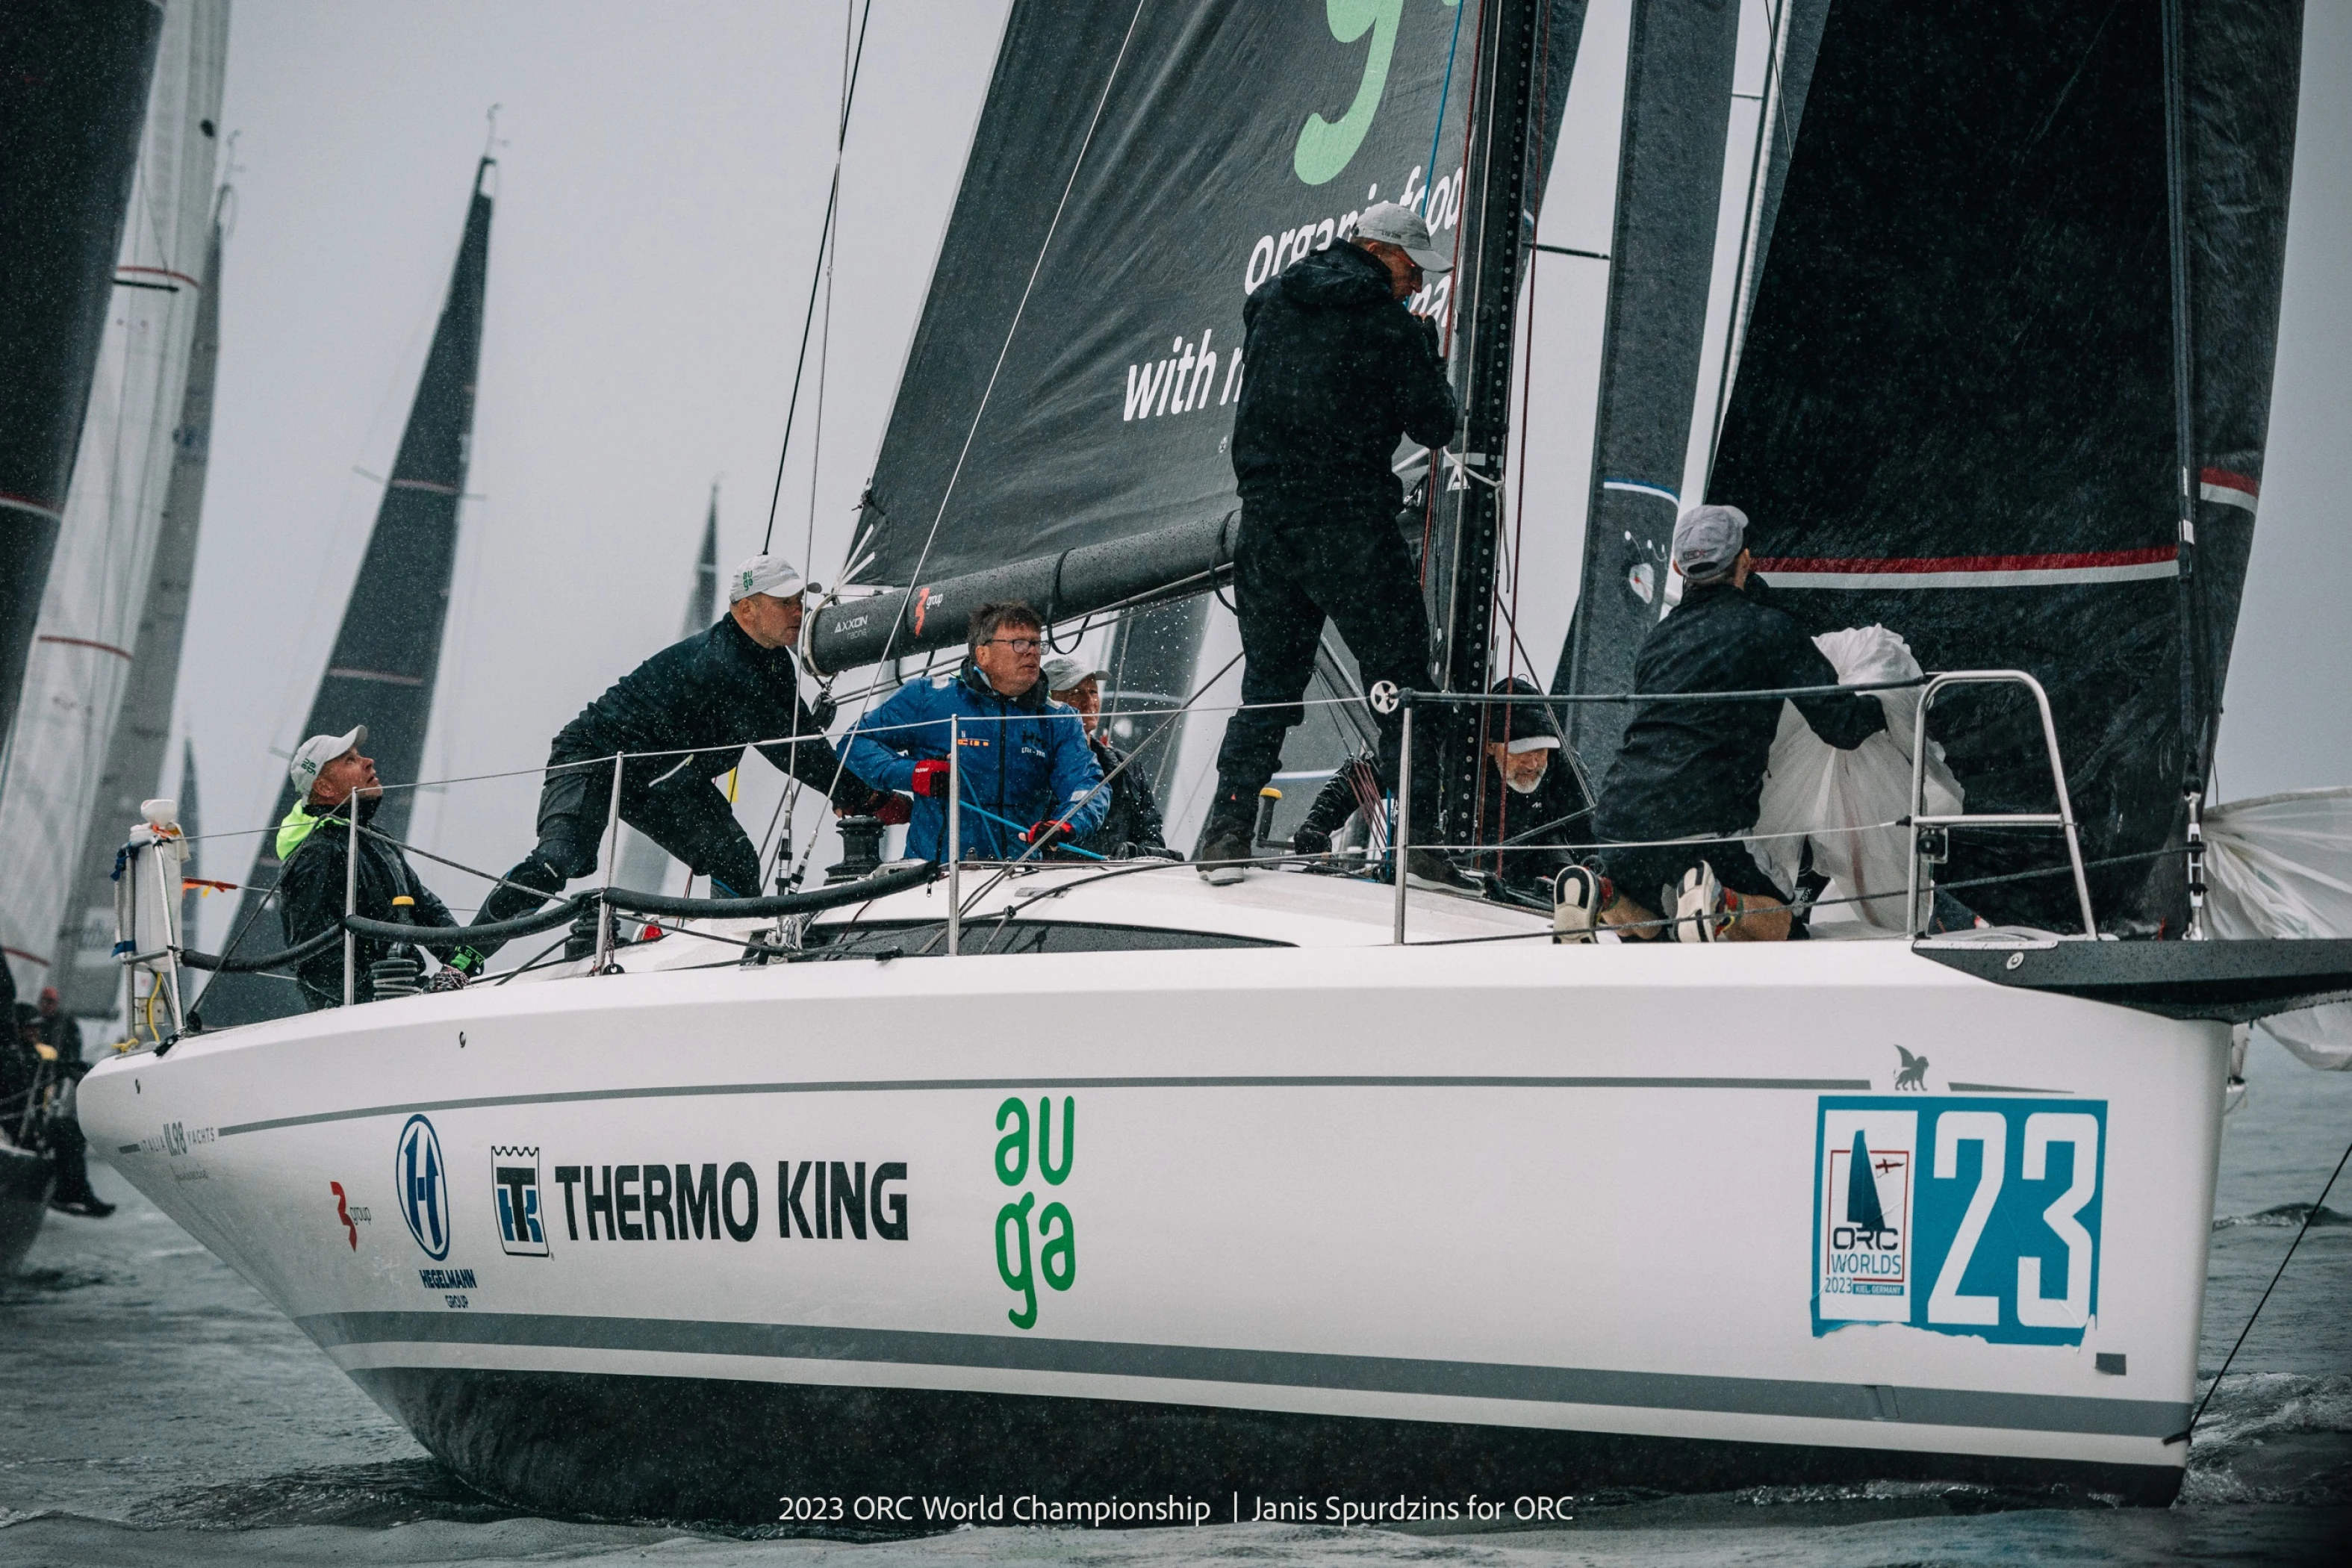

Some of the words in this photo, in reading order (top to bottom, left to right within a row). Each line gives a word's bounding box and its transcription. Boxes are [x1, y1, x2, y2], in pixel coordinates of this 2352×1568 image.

[1123, 328, 1217, 422] with
[926, 594, 944, 610] group
[834, 615, 868, 634] AXXON
[995, 1095, 1075, 1186] au
[555, 1161, 759, 1242] THERMO
[777, 1160, 909, 1241] KING
[349, 1207, 372, 1225] group
[1928, 1110, 2099, 1329] 23
[1832, 1227, 1899, 1251] ORC
[995, 1191, 1076, 1330] ga
[1831, 1254, 1902, 1275] WORLDS
[419, 1269, 478, 1289] HEGELMANN
[1825, 1276, 1852, 1294] 2023
[444, 1294, 469, 1309] GROUP
